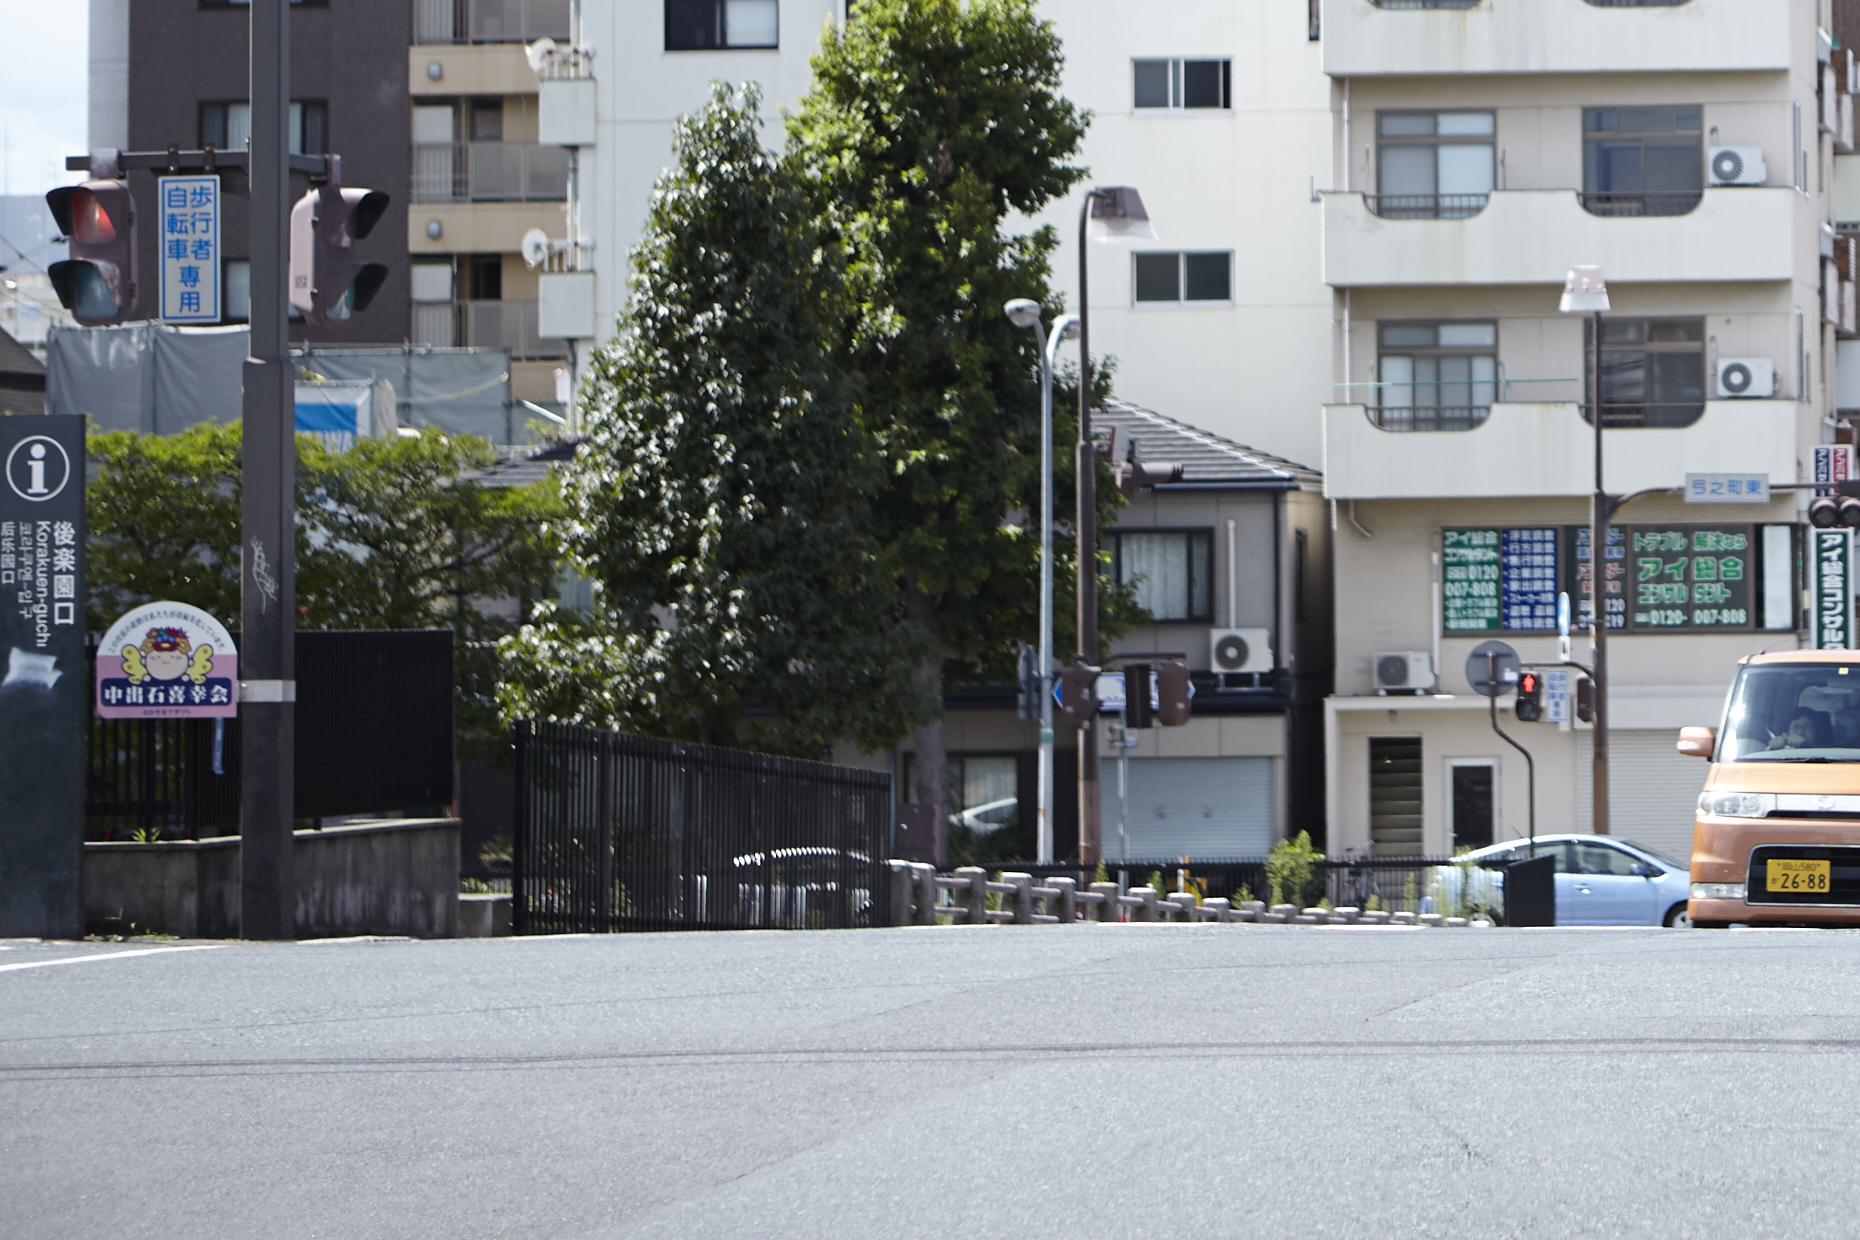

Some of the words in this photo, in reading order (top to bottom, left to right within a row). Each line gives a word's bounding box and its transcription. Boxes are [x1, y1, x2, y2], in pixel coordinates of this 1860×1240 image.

[1692, 479, 1762, 495] 弓之町東
[53, 521, 75, 625] 後楽園口
[1468, 565, 1499, 580] 0120
[33, 521, 51, 647] Korakuen-guchi
[1445, 582, 1497, 597] 007-808
[1781, 873, 1826, 889] 26-88
